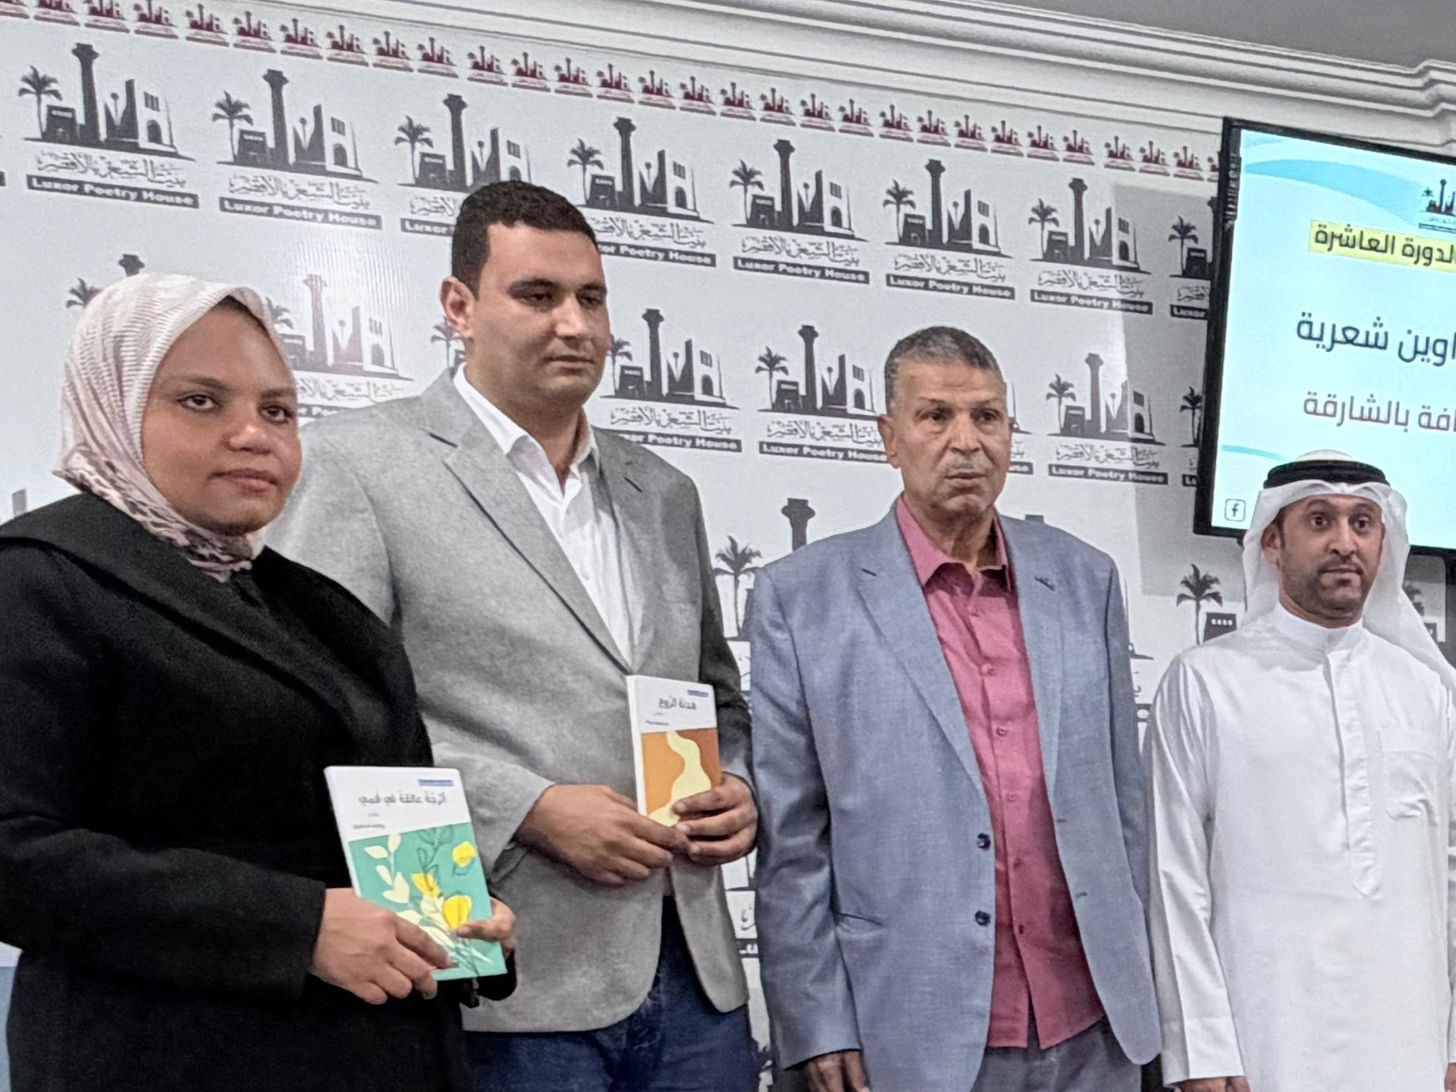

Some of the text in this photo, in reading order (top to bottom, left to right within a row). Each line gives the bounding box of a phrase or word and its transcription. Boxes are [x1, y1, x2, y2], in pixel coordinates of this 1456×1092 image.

[31, 178, 193, 206] Luxor Poetry House
[223, 200, 376, 228] Luxor Poetry House
[1315, 223, 1395, 255] العاشرة
[737, 260, 865, 282] Luxor Poetry House
[1297, 311, 1388, 352] شعرية
[1304, 391, 1409, 432] بالشارقة
